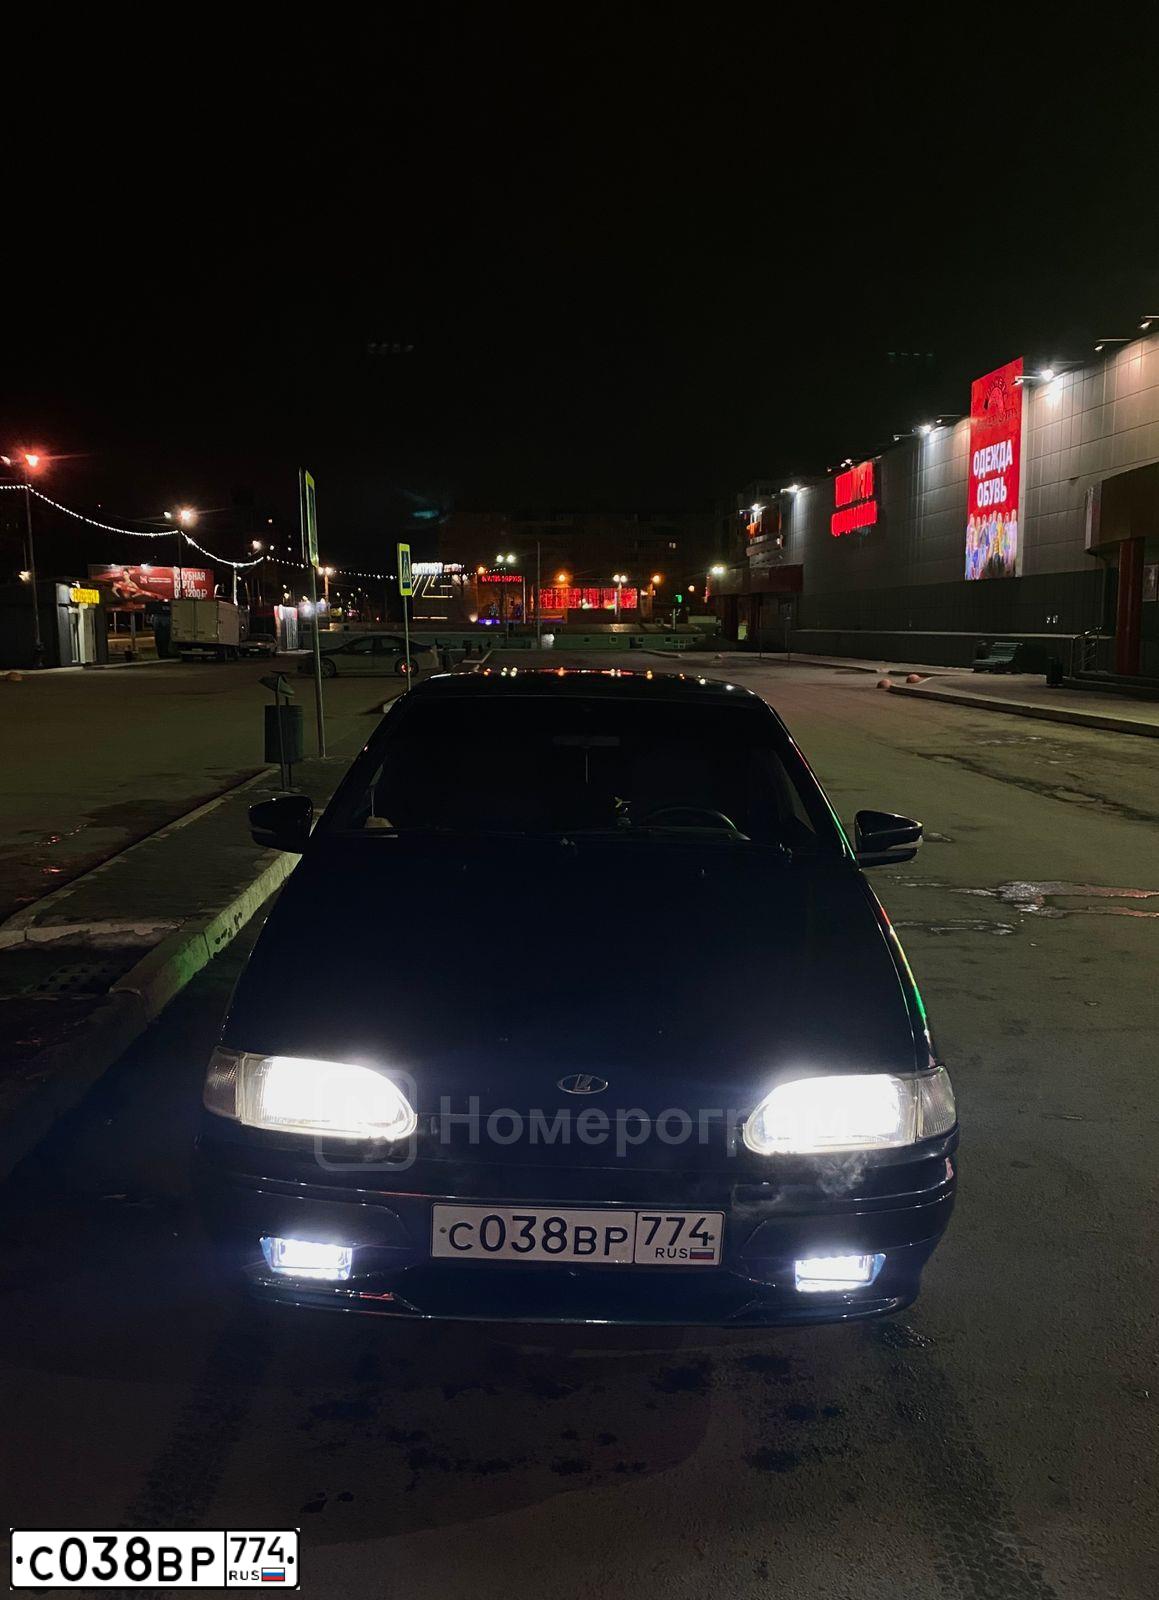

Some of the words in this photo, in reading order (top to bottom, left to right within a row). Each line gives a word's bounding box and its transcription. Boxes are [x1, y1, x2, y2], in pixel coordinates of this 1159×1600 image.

[973, 439, 1013, 478] ОДЕЖДА
[976, 476, 1007, 508] ОБУВЬ
[641, 1216, 709, 1247] 774
[655, 1247, 688, 1259] RUS
